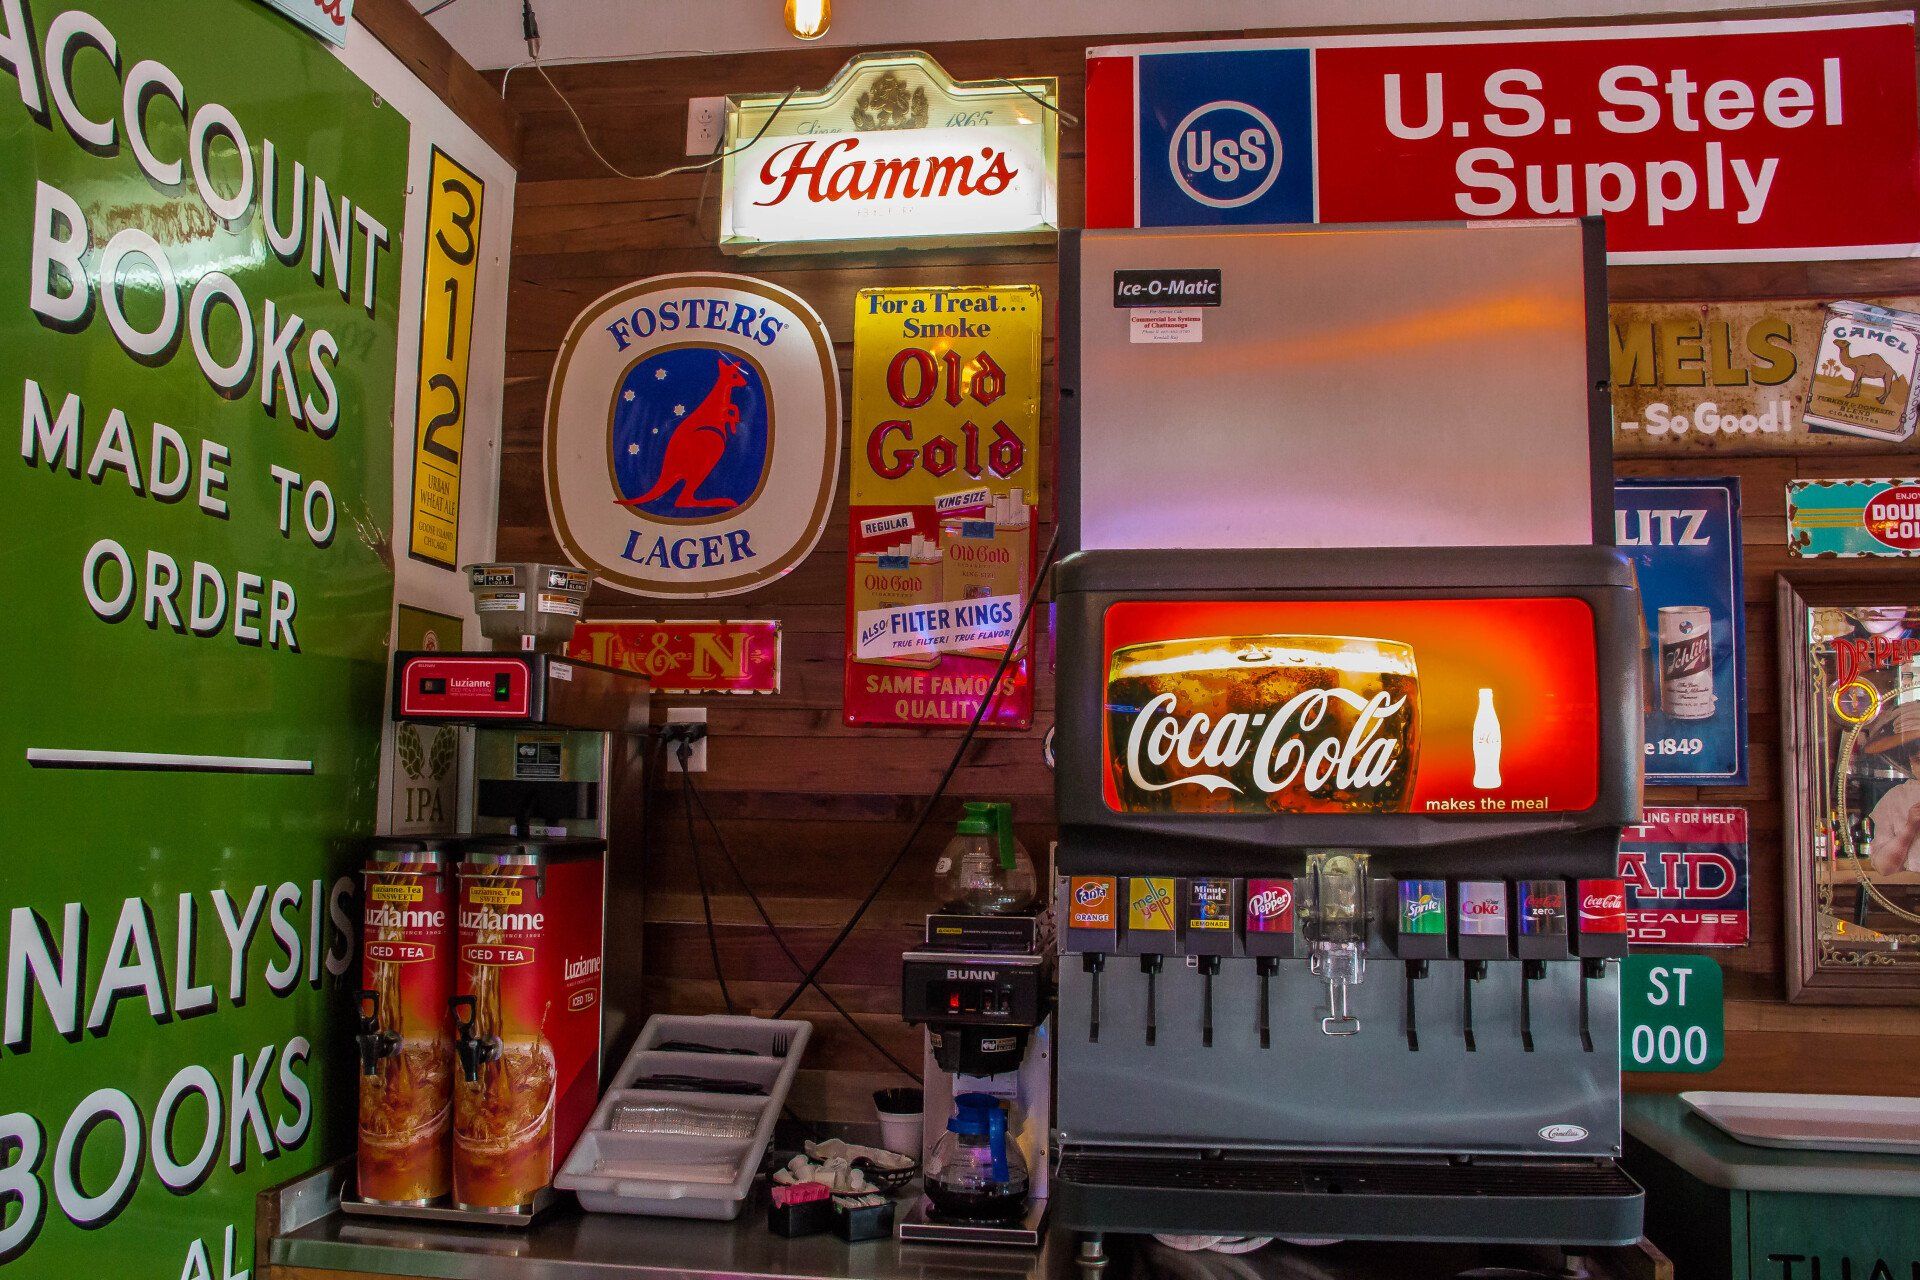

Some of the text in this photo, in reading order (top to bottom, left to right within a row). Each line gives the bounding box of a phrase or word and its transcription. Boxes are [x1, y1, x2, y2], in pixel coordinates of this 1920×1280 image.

[1384, 57, 1842, 140] U.S. Steel
[945, 111, 994, 127] 1865
[1187, 129, 1266, 182] USS
[752, 138, 1018, 206] Hamm's
[1455, 142, 1779, 226] Supply
[1118, 280, 1217, 296] Ice-O-Matic
[30, 180, 339, 433] BOOKS
[867, 295, 908, 314] For
[911, 299, 927, 313] a
[423, 179, 476, 465] 312
[606, 299, 783, 352] FOSTER'S
[903, 318, 991, 339] Smoke
[1833, 326, 1910, 354] CAMEL
[1610, 319, 1798, 387] MELS
[887, 348, 1007, 409] Old
[1645, 402, 1690, 434] So
[1694, 402, 1792, 434] Good!
[866, 420, 1025, 480] Gold
[22, 379, 336, 545] MADE TO
[428, 474, 450, 495] URBAN
[420, 489, 443, 511] WHEAT
[937, 491, 986, 510] KING SIZE
[865, 517, 909, 534] REGULAR
[1615, 509, 1710, 546] LITZ
[621, 529, 757, 569] LAGER
[950, 543, 1010, 563] Old Gold
[83, 539, 298, 648] ORDER
[865, 574, 922, 592] Old Gold
[891, 601, 1013, 635] FILTER KINGS
[892, 628, 1014, 649] TRUE FILTER! TRUE FLAVOR!
[450, 678, 491, 688] Luzianne
[866, 675, 924, 694] SAME
[1128, 687, 1406, 794] Coca-Cola
[1658, 738, 1703, 755] 1849
[405, 787, 445, 823] IPA
[1426, 796, 1549, 810] makes the meal
[1673, 813, 1699, 824] FOR
[1702, 813, 1736, 825] HELP
[1618, 851, 1737, 899] AID
[373, 885, 421, 894] Luzianne Tea
[377, 893, 414, 901] UNSWEET
[471, 888, 504, 896] Luzianne
[479, 895, 507, 903] SWEET
[1194, 885, 1227, 895] Minute
[1198, 892, 1222, 901] Maid
[1263, 890, 1278, 902] Dr
[1252, 894, 1288, 916] Pepper
[1407, 899, 1439, 917] Sprite
[1462, 900, 1499, 915] Coke
[1583, 894, 1622, 909] Coca-Cola
[365, 903, 446, 928] uzianne
[459, 904, 545, 930] Luzianne
[1074, 913, 1109, 921] ORANGE
[1191, 920, 1228, 928] LEMONADE
[370, 945, 425, 958] ICED TEA
[468, 950, 525, 961] ICED TEA
[564, 954, 601, 980] Luzianne
[946, 969, 996, 981] BUNN
[1647, 966, 1693, 1006] ST
[1631, 1024, 1708, 1065] 000
[0, 1037, 311, 1252] BOOKS
